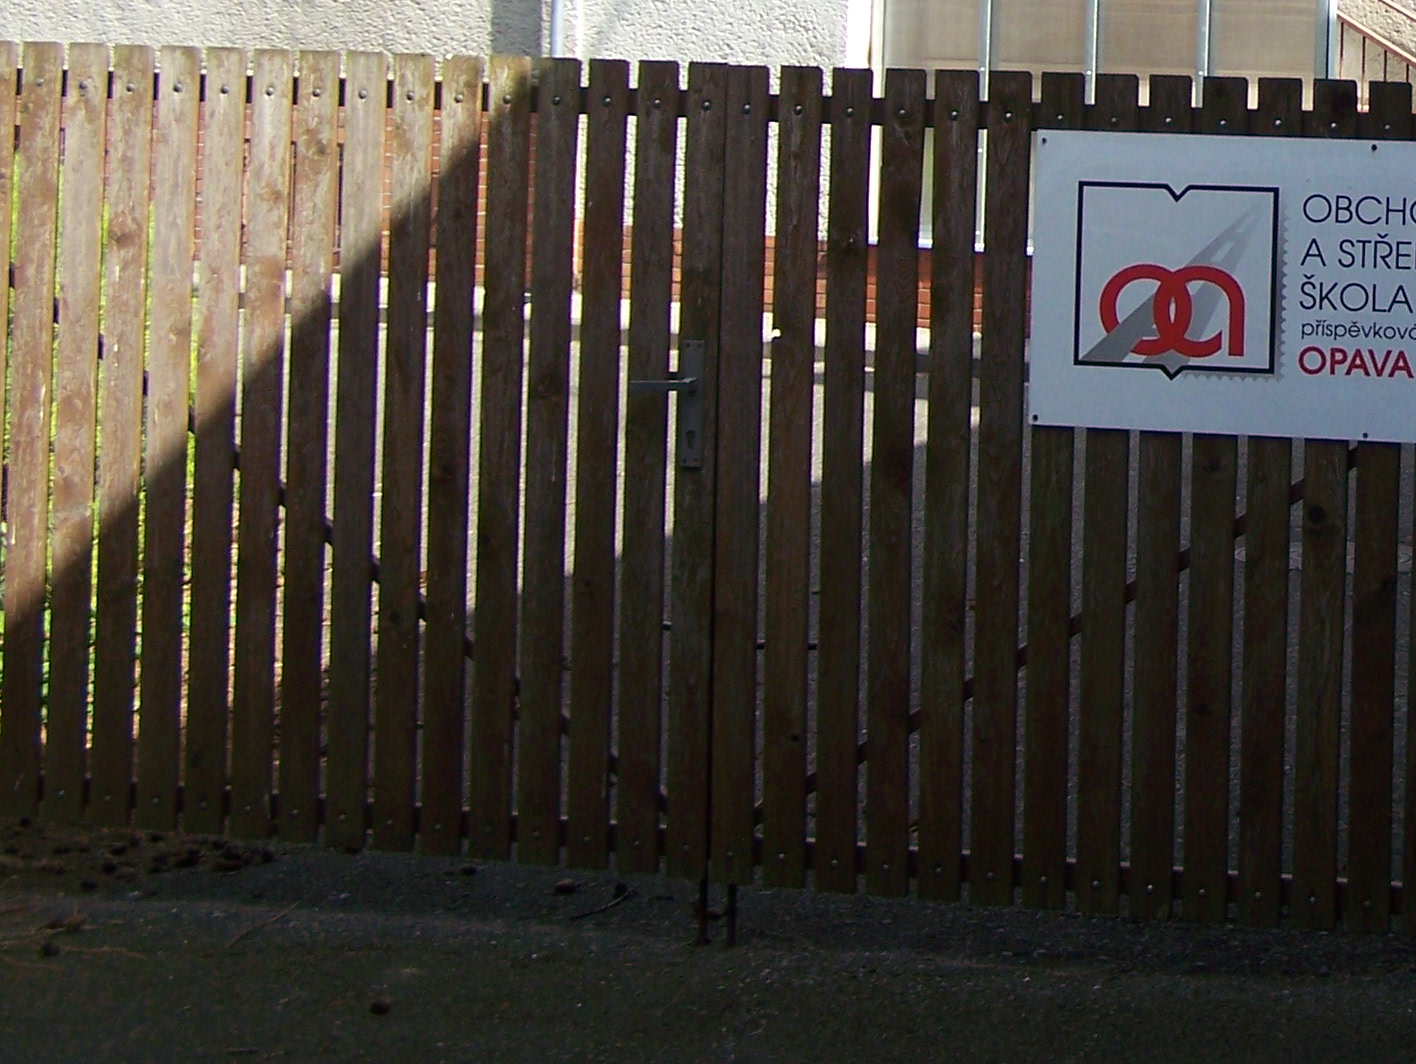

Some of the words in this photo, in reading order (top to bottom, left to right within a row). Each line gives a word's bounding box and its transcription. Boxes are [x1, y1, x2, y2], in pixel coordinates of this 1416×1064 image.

[1300, 238, 1327, 267] A
[1299, 273, 1414, 314] ŠKOLA
[1298, 345, 1415, 379] OPAVA
